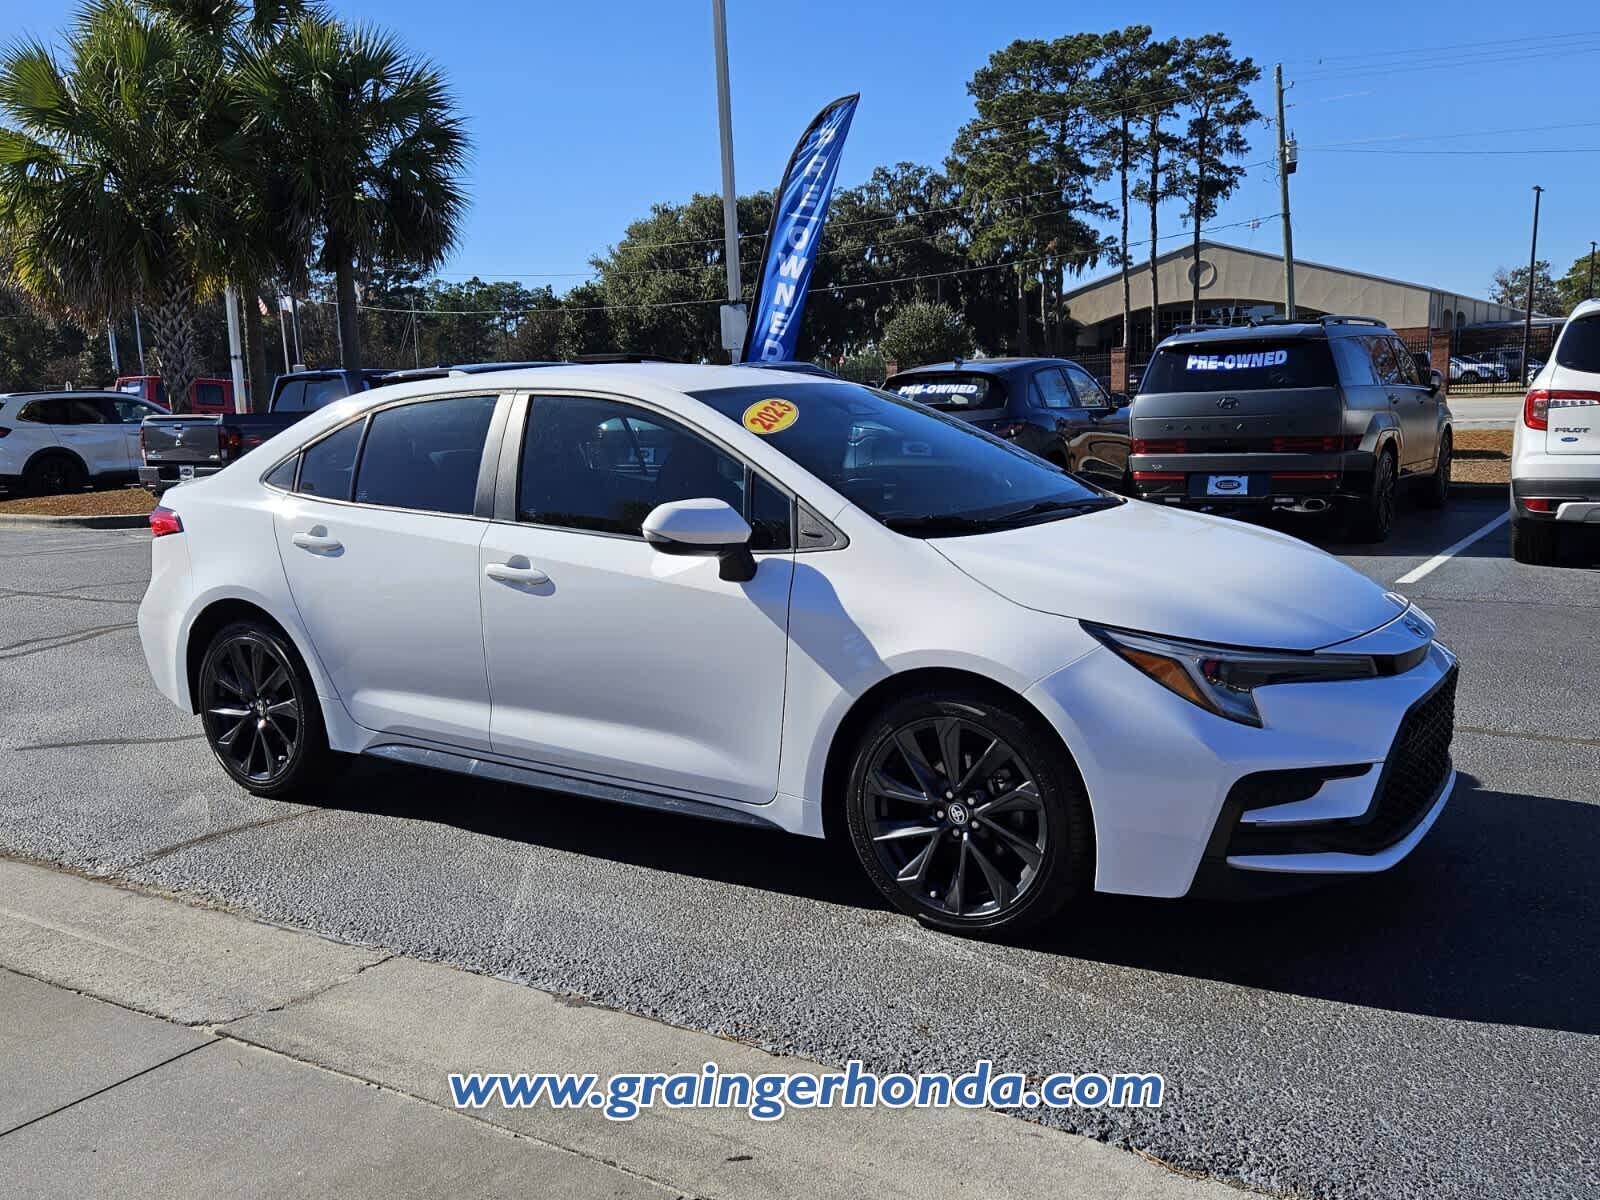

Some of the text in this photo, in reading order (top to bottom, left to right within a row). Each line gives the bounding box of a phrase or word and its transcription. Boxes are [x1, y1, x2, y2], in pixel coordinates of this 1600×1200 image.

[1186, 350, 1288, 370] PRE-OWNED
[898, 384, 978, 395] PRE-OWNED
[750, 400, 792, 431] 2023
